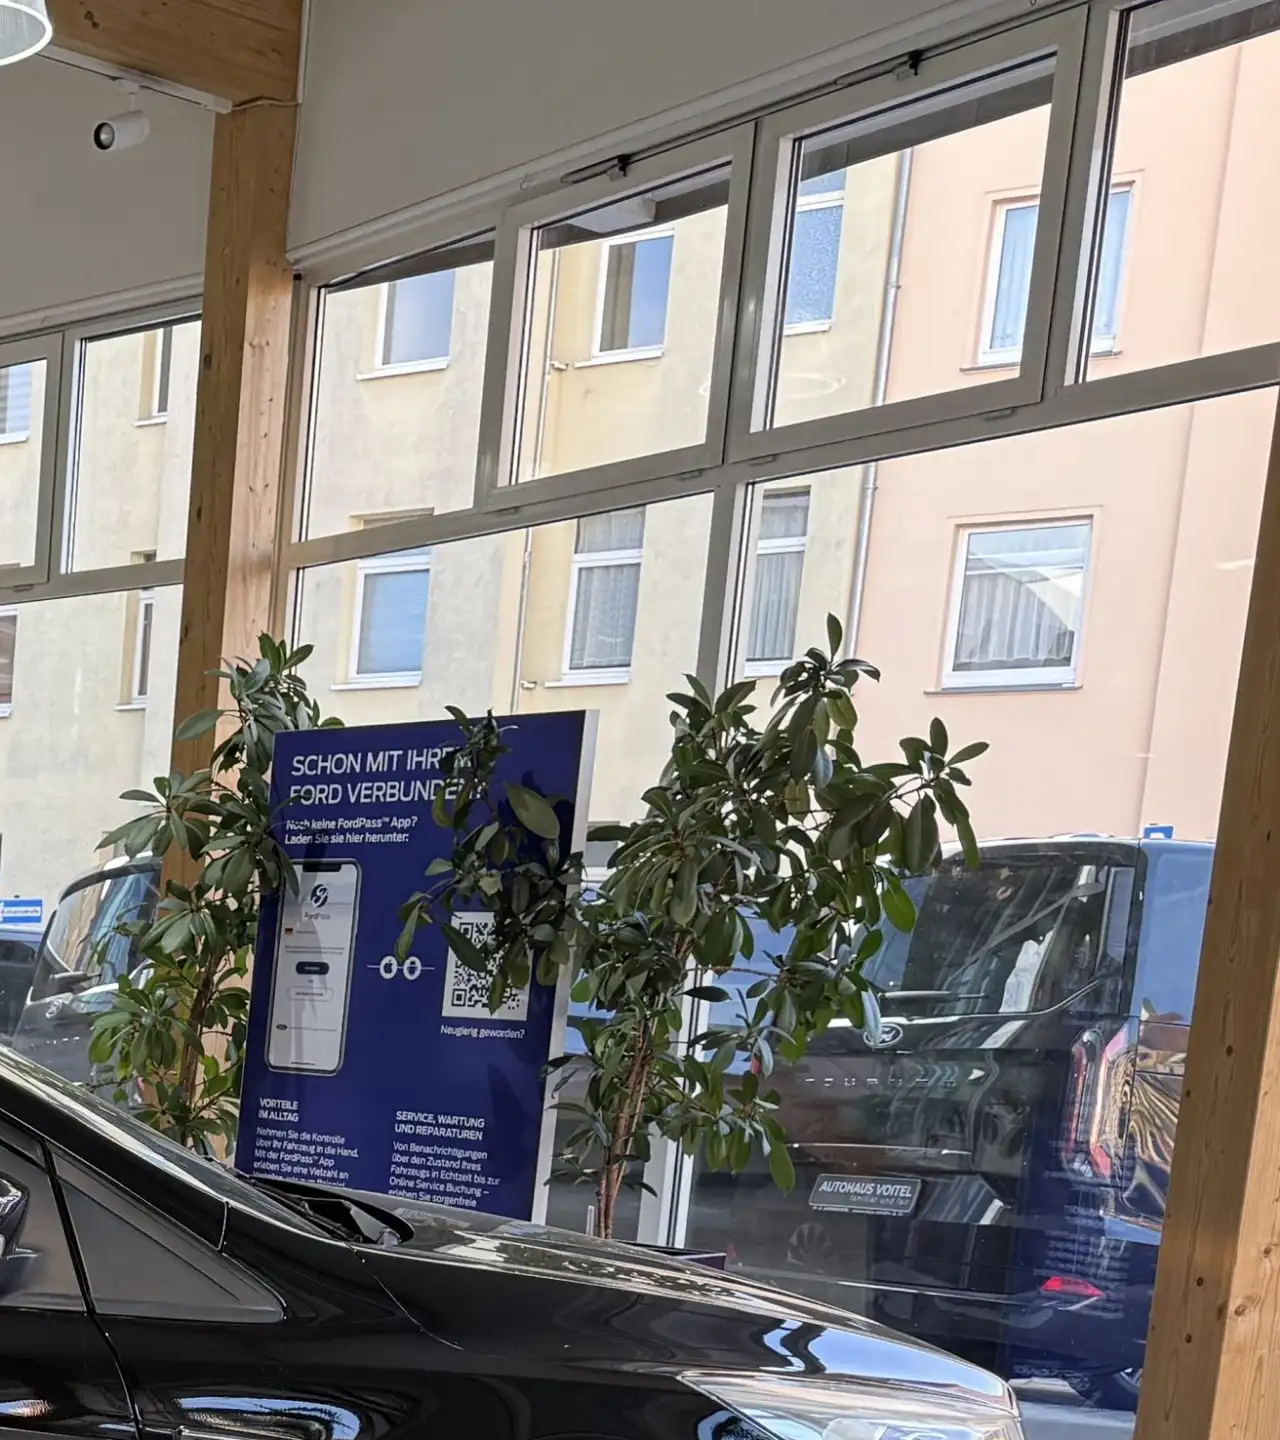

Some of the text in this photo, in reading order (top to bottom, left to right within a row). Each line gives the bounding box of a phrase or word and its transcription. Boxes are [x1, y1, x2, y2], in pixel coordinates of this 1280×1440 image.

[291, 752, 362, 776] SCHON
[366, 751, 403, 773] MIT
[289, 784, 343, 806] FORD
[286, 819, 310, 831] Noch
[311, 818, 336, 830] keine
[390, 815, 418, 830] App?
[285, 831, 409, 845] Laden Sie sie hier herunter:
[440, 1025, 525, 1039] Neugierig geworden?
[260, 1098, 298, 1110] VORTEILE
[258, 1110, 299, 1122] IM ALLTAG
[396, 1110, 485, 1128] SERVICE, WARTUNG
[256, 1126, 345, 1144] Nehmen Sie die Kontrolle
[395, 1123, 483, 1140] UND REPARATUREN
[256, 1138, 272, 1147] über
[272, 1140, 282, 1148] Ihr
[282, 1141, 315, 1154] Fahrzeug
[324, 1146, 336, 1154] die
[337, 1147, 359, 1157] Hand.
[393, 1141, 488, 1160] Von Benachrichtigungen
[254, 1149, 266, 1158] Mit
[267, 1150, 279, 1159] der
[319, 1157, 335, 1167] App
[392, 1153, 482, 1172] über den Zustand Ihres
[253, 1160, 280, 1171] erleben
[280, 1163, 292, 1173] Sie
[293, 1165, 308, 1174] eine
[309, 1167, 338, 1179] Vielzahl
[339, 1171, 349, 1179] an
[390, 1165, 430, 1179] Fahrzeugs
[440, 1170, 472, 1183] Echtzeit
[474, 1174, 486, 1184] bis
[486, 1177, 500, 1185] zur
[389, 1177, 415, 1188] Online
[416, 1179, 445, 1192] Service
[446, 1183, 482, 1197] Buchung
[819, 1180, 913, 1197] AUTOHAUS VOITEL
[419, 1191, 431, 1202] Sie
[432, 1193, 477, 1208] sorgenfreie
